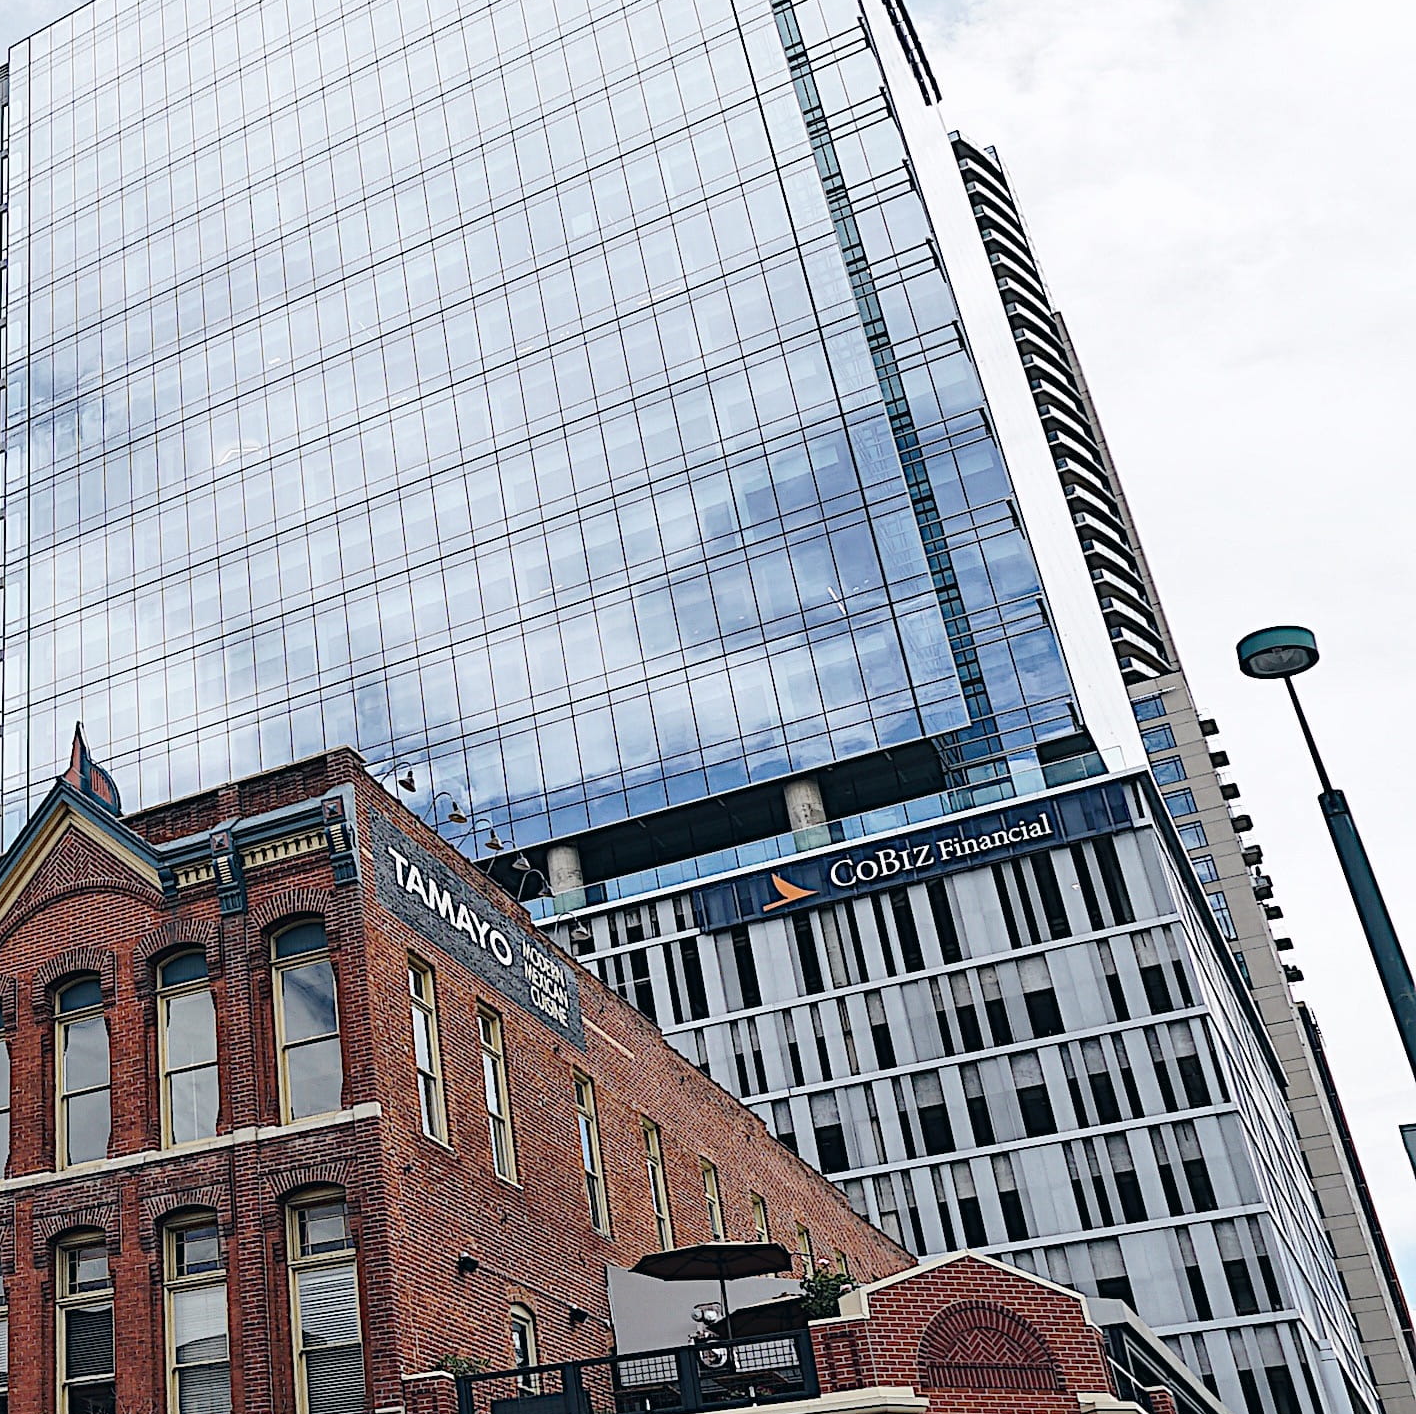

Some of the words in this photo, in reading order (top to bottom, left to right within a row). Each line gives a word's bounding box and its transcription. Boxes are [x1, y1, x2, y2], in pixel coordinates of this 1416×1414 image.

[936, 812, 1054, 862] Financial
[388, 846, 513, 966] TAMAYO
[522, 939, 566, 988] MODERN
[524, 960, 569, 1010] MEXICAN
[530, 985, 569, 1028] CUISINE
